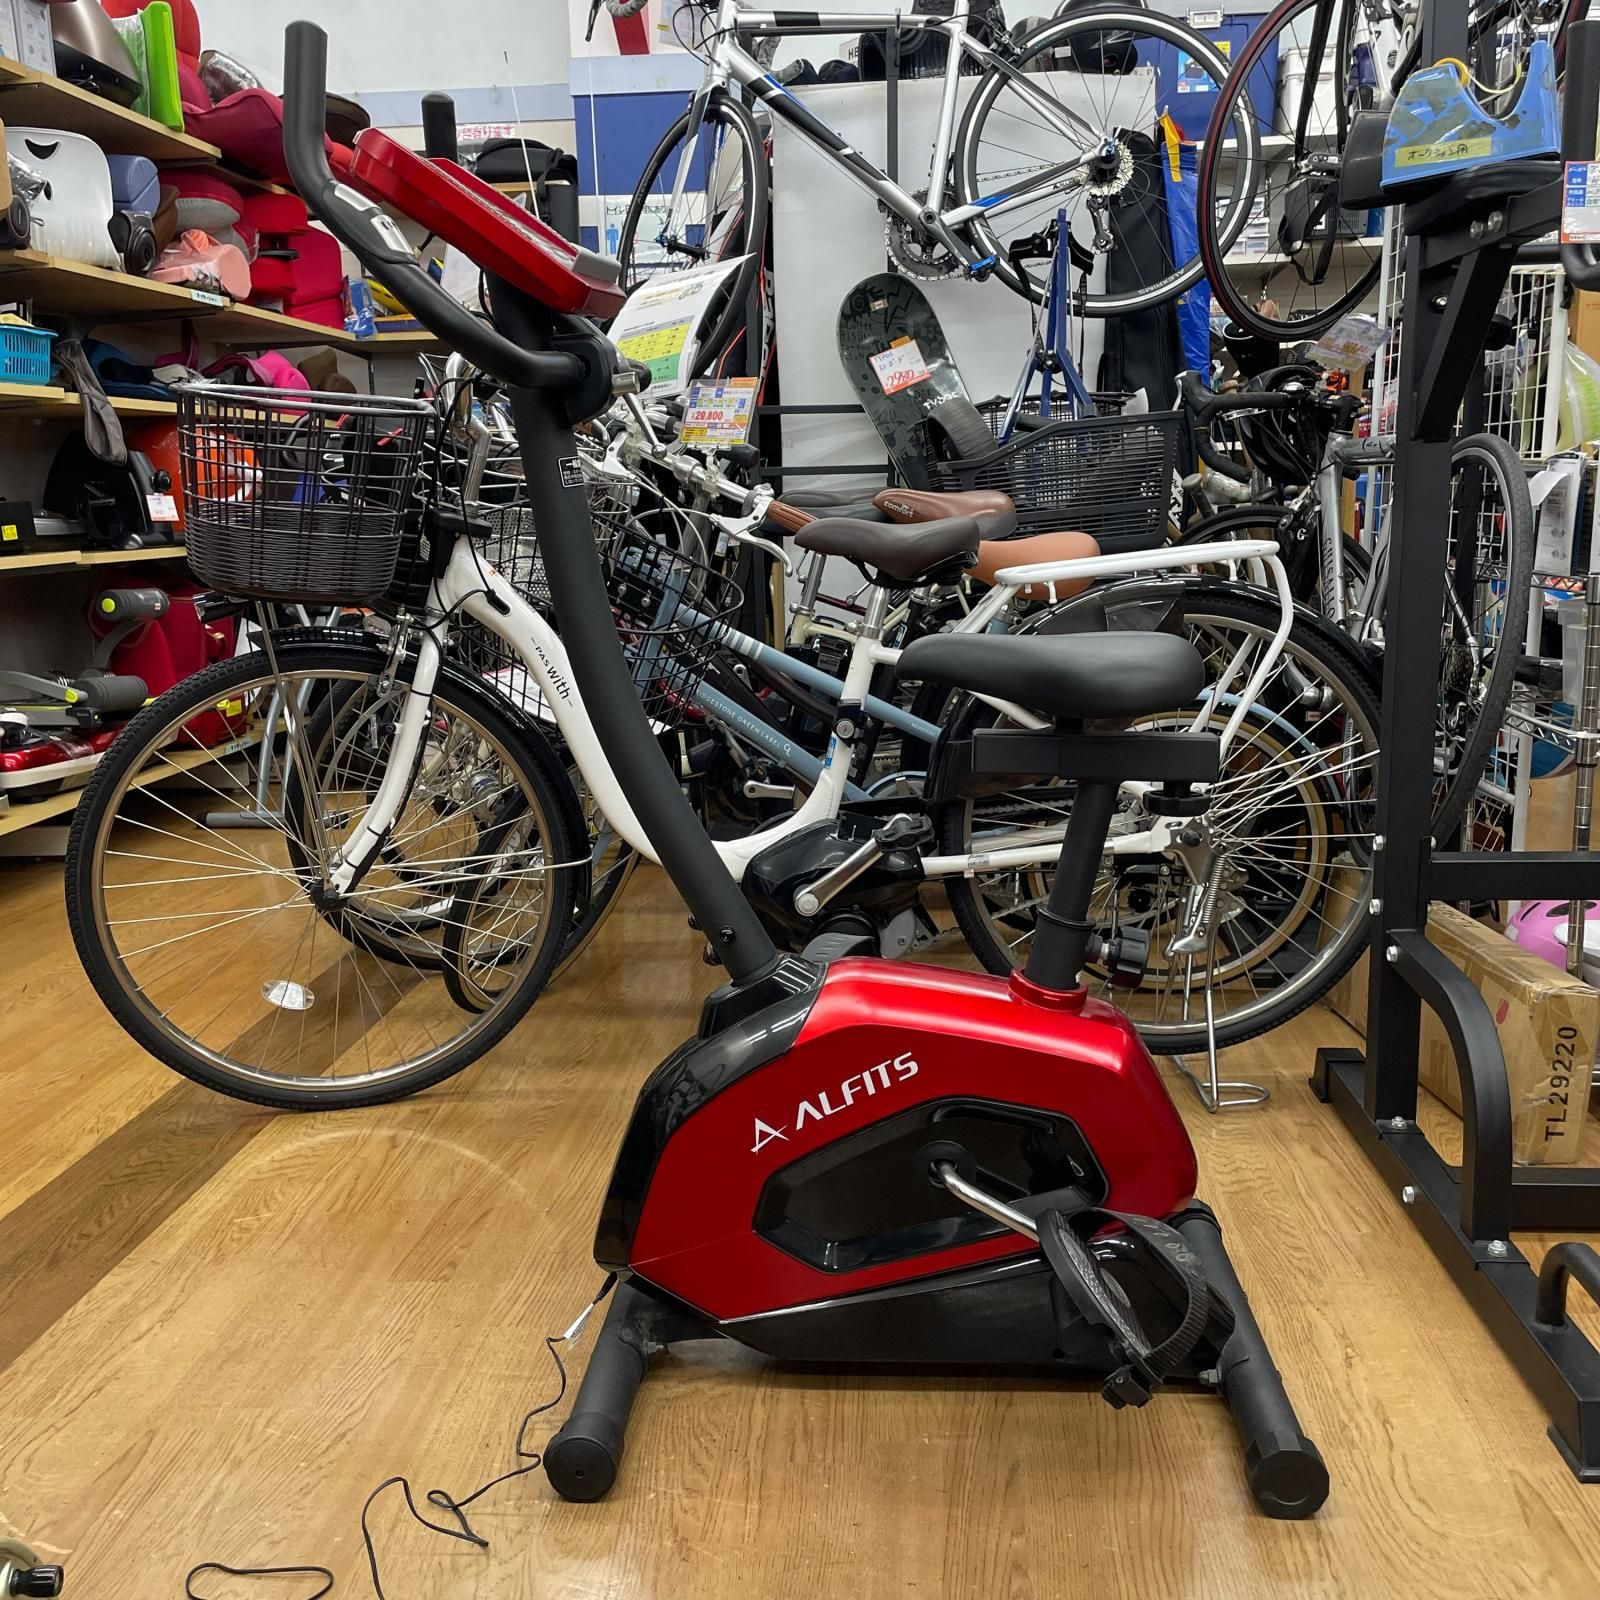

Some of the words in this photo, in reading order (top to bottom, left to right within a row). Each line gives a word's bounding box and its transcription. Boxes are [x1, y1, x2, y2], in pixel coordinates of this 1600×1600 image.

[1137, 268, 1185, 295] ALEXRIMS
[535, 646, 549, 667] PAS
[694, 688, 736, 718] RIDGESTONE
[760, 731, 781, 749] LABEL
[795, 1051, 919, 1131] ALFITS
[1544, 1026, 1578, 1142] TL29220
